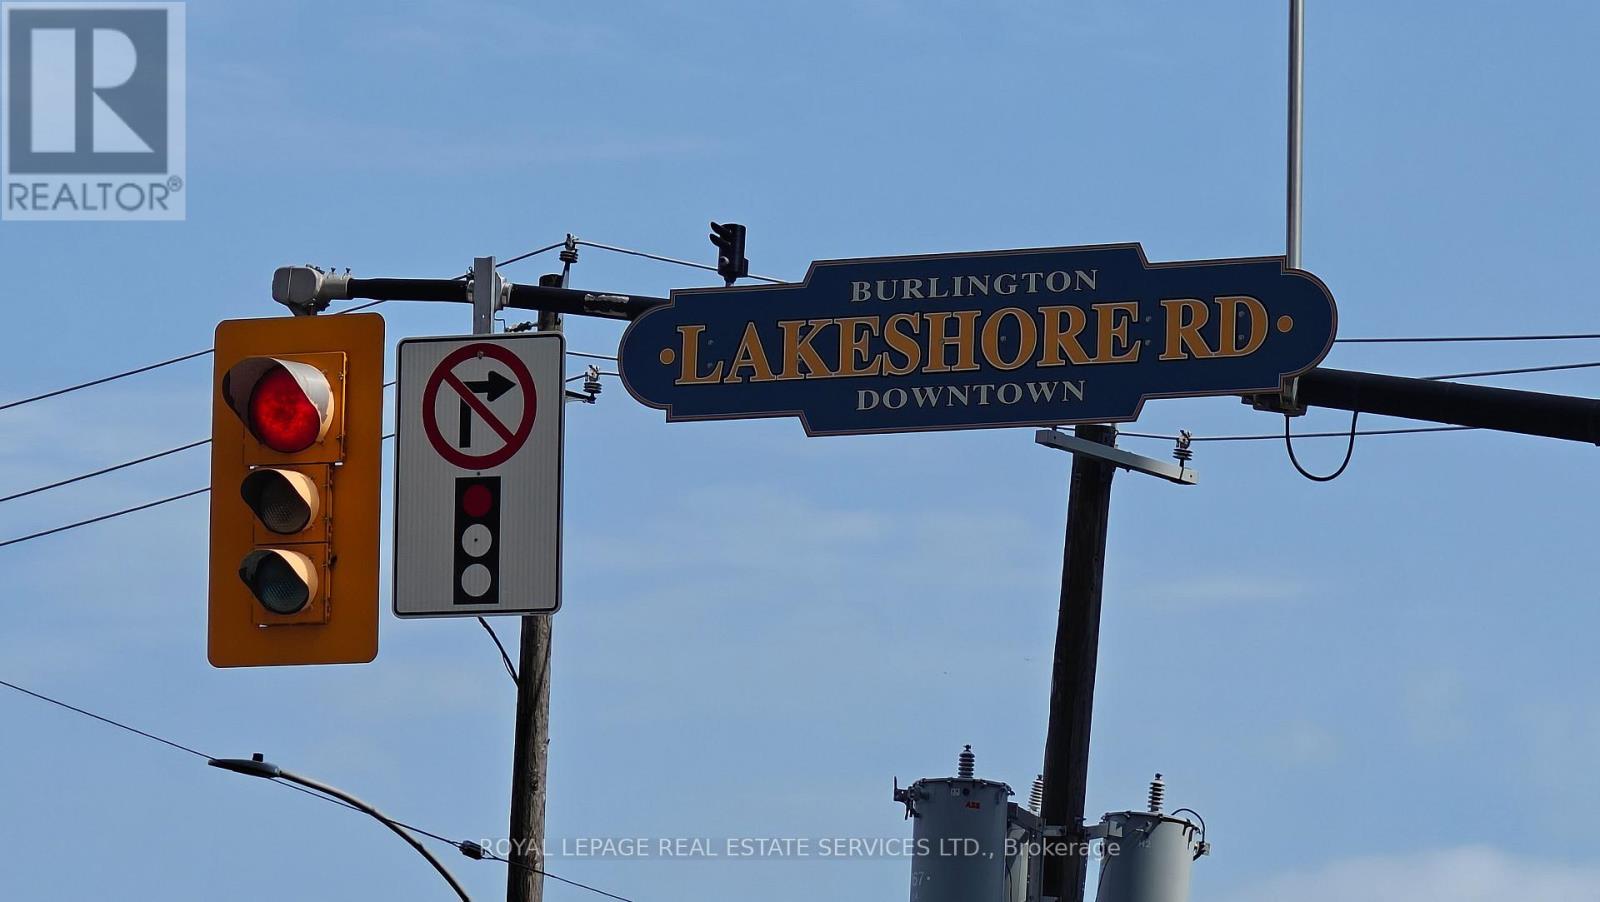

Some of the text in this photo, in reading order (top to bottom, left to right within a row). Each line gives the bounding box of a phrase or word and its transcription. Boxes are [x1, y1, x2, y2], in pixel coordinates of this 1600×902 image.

[850, 269, 1100, 302] BURLINGTON
[674, 295, 1270, 386] LAKESHORE RD
[856, 380, 1086, 411] DOWNTOWN
